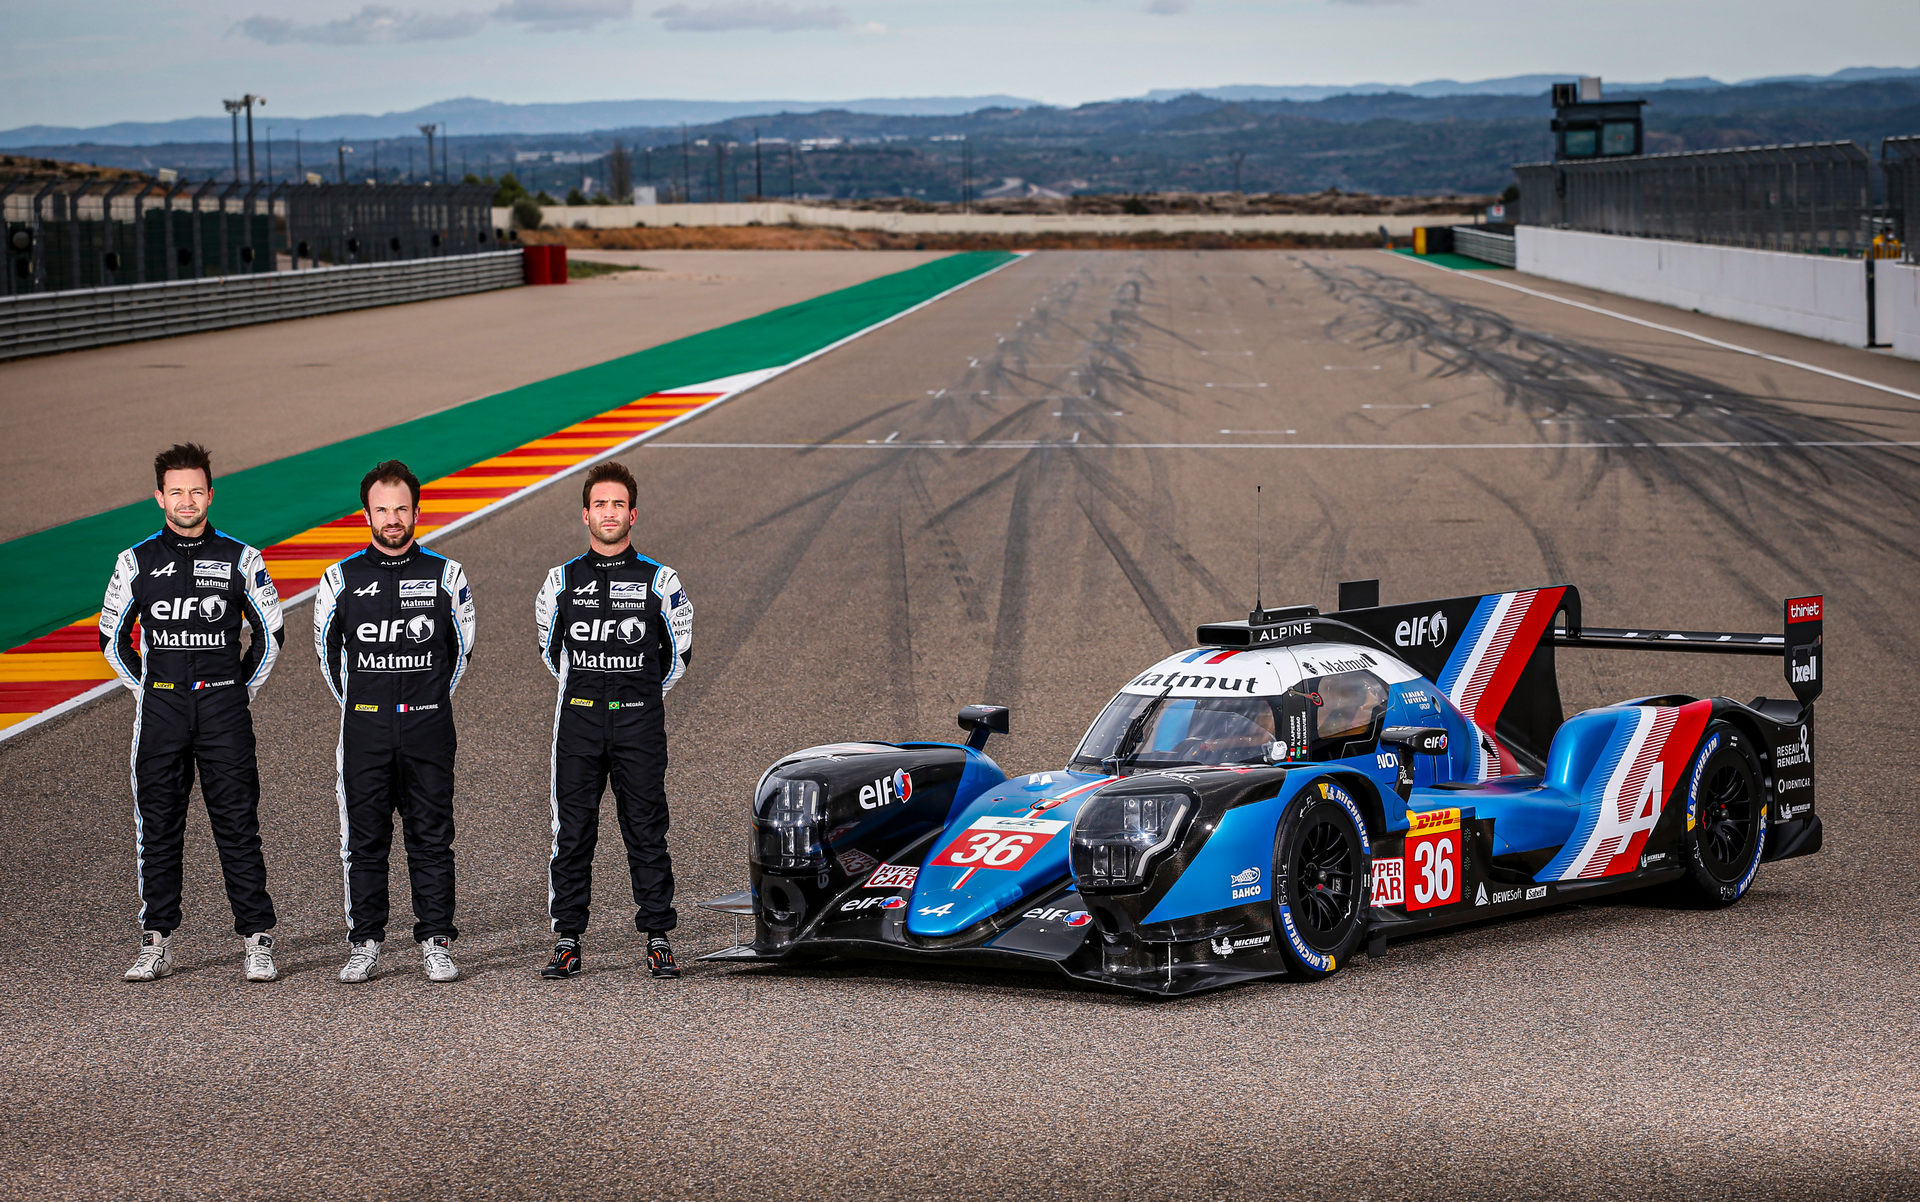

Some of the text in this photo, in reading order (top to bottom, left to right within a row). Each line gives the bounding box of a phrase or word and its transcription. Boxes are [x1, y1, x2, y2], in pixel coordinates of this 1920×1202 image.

[195, 578, 229, 589] Matmut
[151, 597, 199, 620] elf
[401, 598, 435, 608] Matmut
[572, 598, 600, 606] NOVAC
[611, 600, 645, 609] Matmut
[1790, 602, 1820, 618] thiriet
[152, 630, 227, 647] Matmut
[356, 620, 405, 643] elf
[570, 619, 617, 641] elf
[1259, 623, 1312, 641] ALPINE
[1394, 616, 1429, 647] elf
[357, 650, 433, 669] Matmut
[573, 650, 645, 669] Matmut
[1318, 655, 1373, 674] Matmut
[1792, 655, 1816, 683] ixell
[1424, 736, 1440, 748] elf
[1776, 743, 1800, 757] RESEAU
[1690, 737, 1718, 801] MICHELIN
[1777, 753, 1805, 768] RENAULT
[859, 776, 893, 810] elf
[1335, 789, 1370, 848] MICHELIN
[1416, 810, 1454, 829] DHL
[950, 832, 1034, 866] 36
[1371, 861, 1401, 877] YPER
[1414, 837, 1454, 904] 36
[870, 874, 916, 887] CAR
[1370, 877, 1402, 902] AR
[1232, 885, 1261, 900] BAHCO
[1492, 888, 1522, 904] DEWESoft
[840, 897, 884, 912] elf
[1022, 907, 1066, 921] elf
[1233, 935, 1271, 947] MICHELIN
[1283, 912, 1321, 967] MICHELIN
